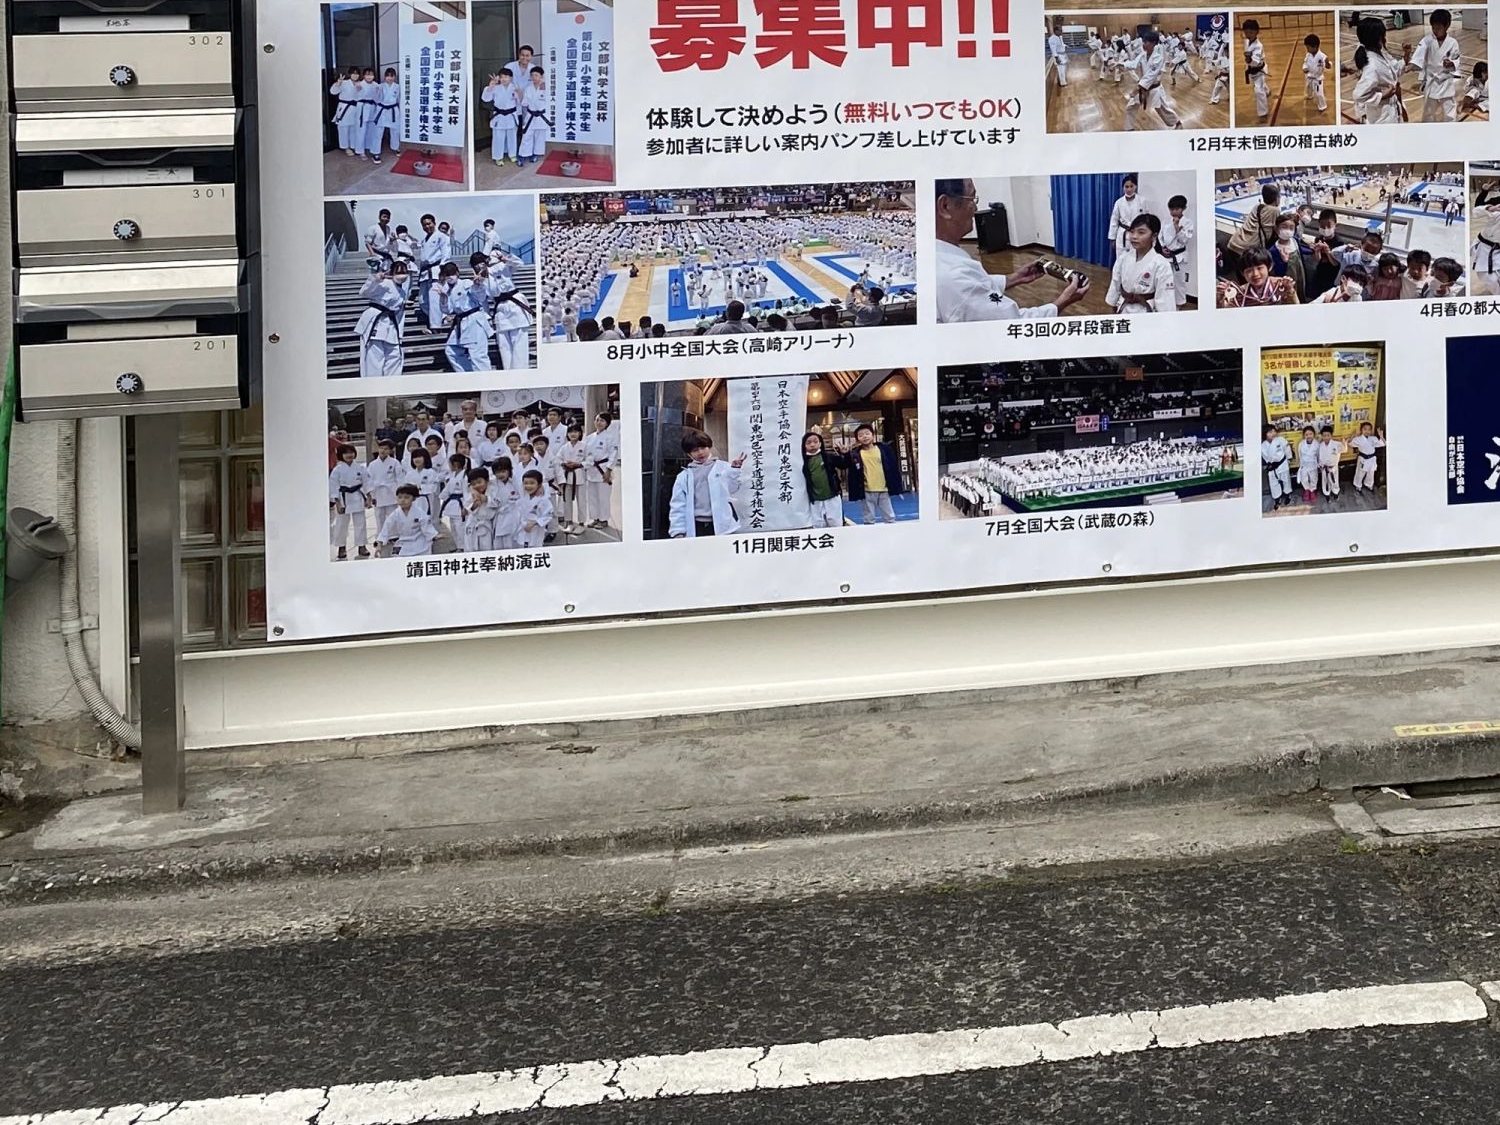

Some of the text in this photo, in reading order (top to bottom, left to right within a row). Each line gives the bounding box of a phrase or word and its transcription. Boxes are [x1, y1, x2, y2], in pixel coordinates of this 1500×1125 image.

[188, 35, 224, 46] 302
[645, 97, 1022, 131] 体験して決めよう(無料いつでもOK)
[645, 126, 1022, 157] 参加者に詳しい案内パンフ差し上げています
[1188, 132, 1358, 153] 12月年末恒例の稽古納め
[192, 188, 225, 198] 301
[1006, 317, 1132, 340] 年3回の昇段審査
[193, 340, 227, 350] 201
[606, 332, 856, 360] 8月小中全国大会(高崎アリーナ)
[984, 511, 1156, 538] 7月全国大会(武蔵の森)
[733, 534, 836, 555] 11月関東大会
[406, 552, 552, 578] 靖国神社奉納演武
